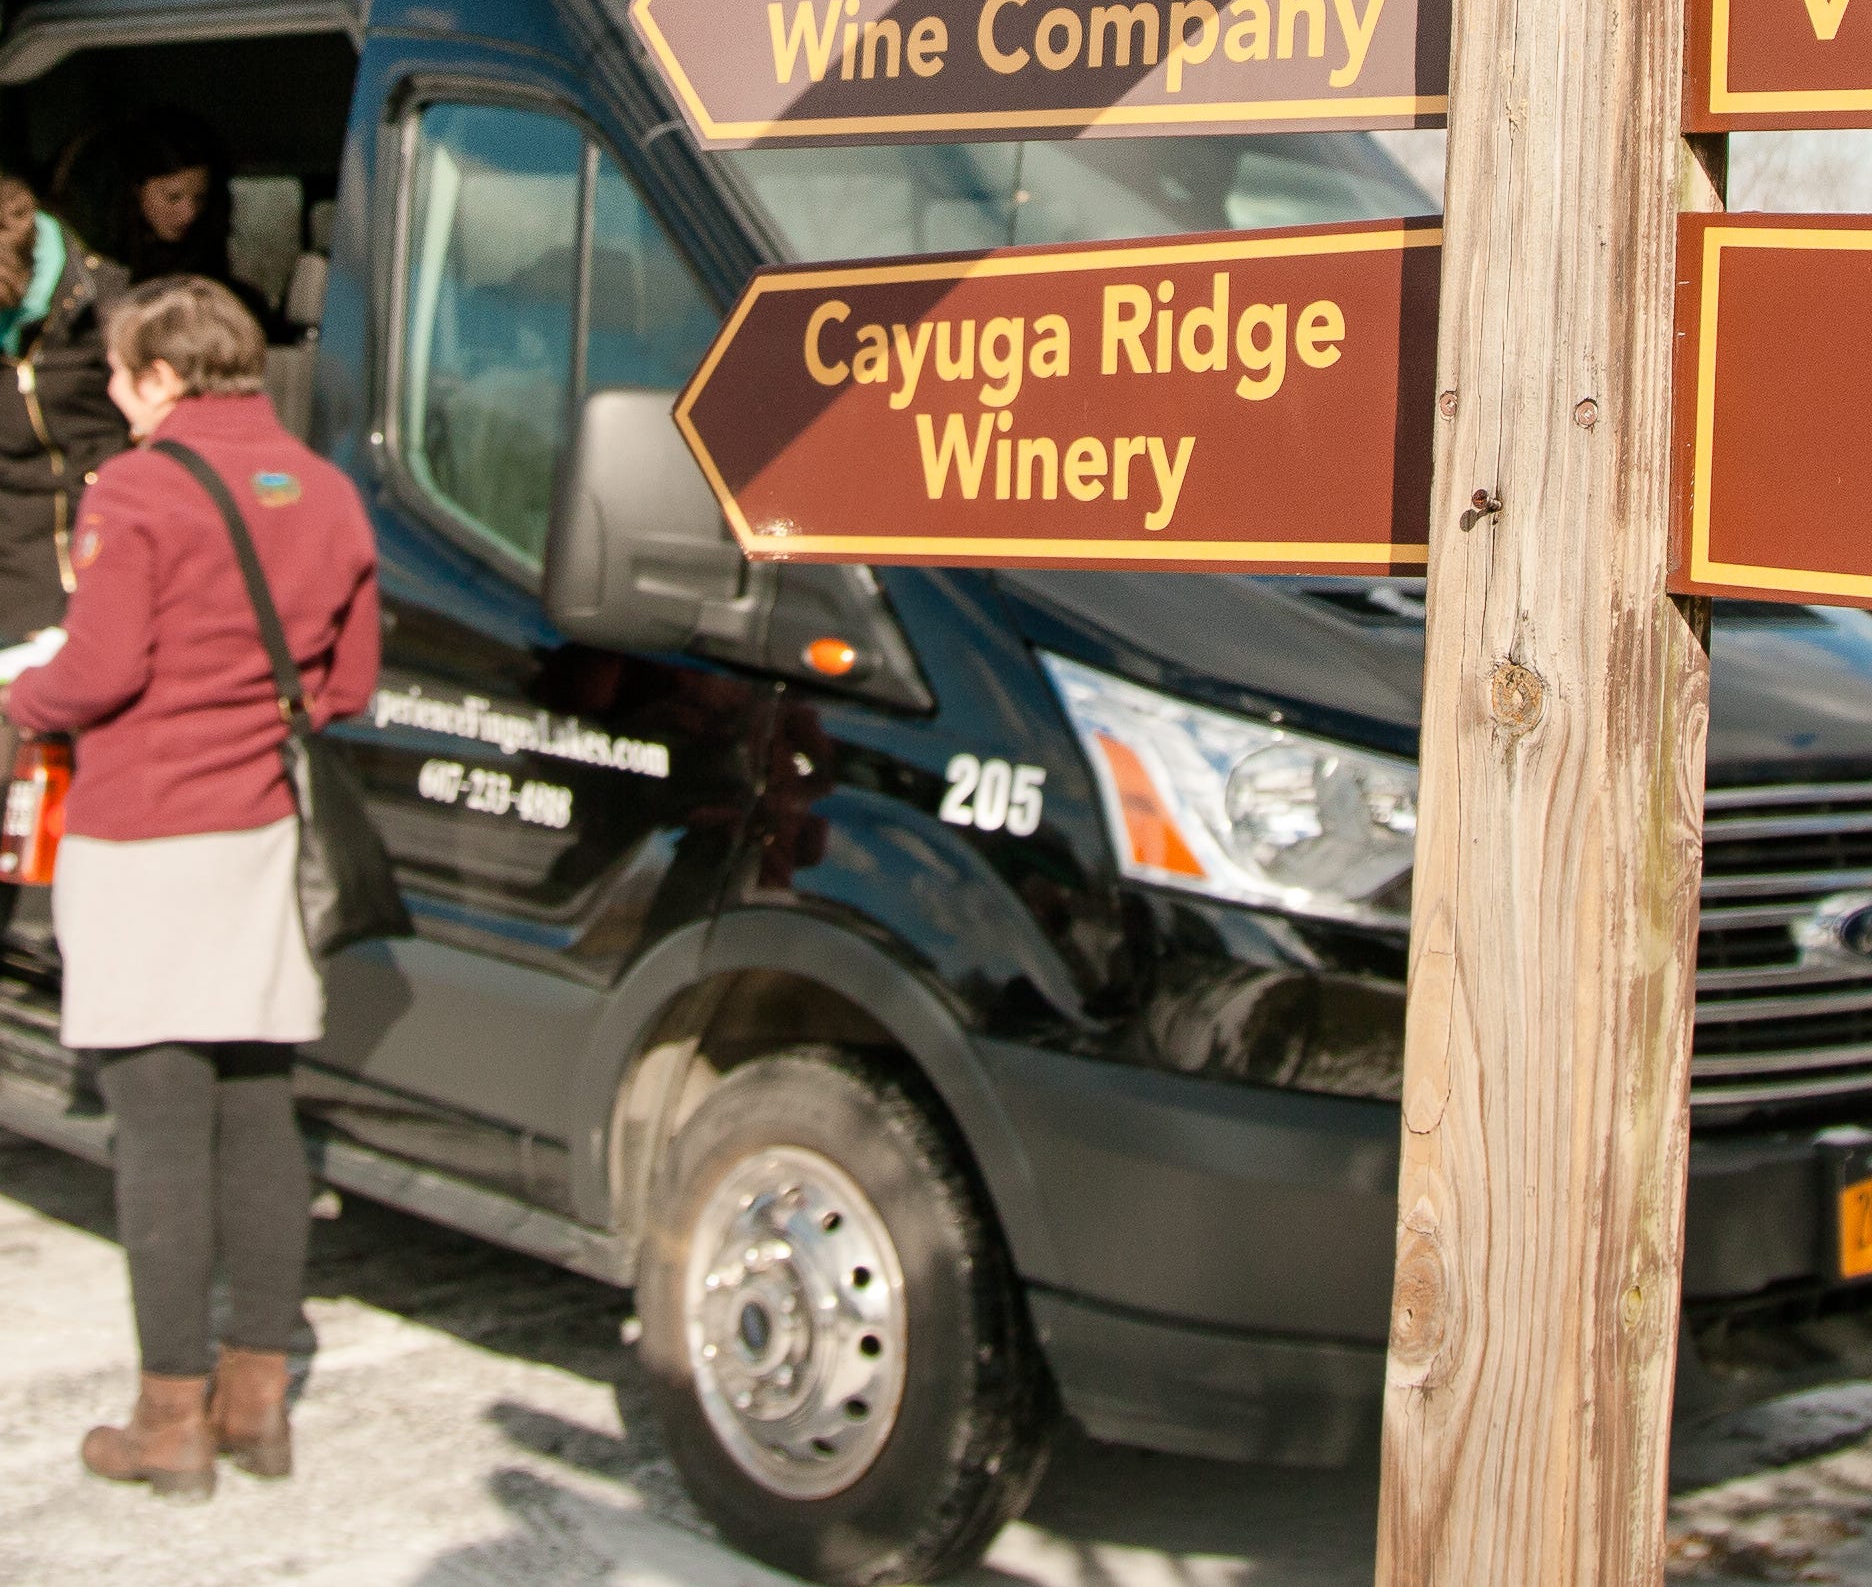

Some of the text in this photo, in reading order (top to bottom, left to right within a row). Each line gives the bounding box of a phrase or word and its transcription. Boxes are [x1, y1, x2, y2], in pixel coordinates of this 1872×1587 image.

[804, 272, 1346, 411] Cayuga Ridge
[914, 408, 1197, 531] Winery
[939, 753, 1047, 837] 205
